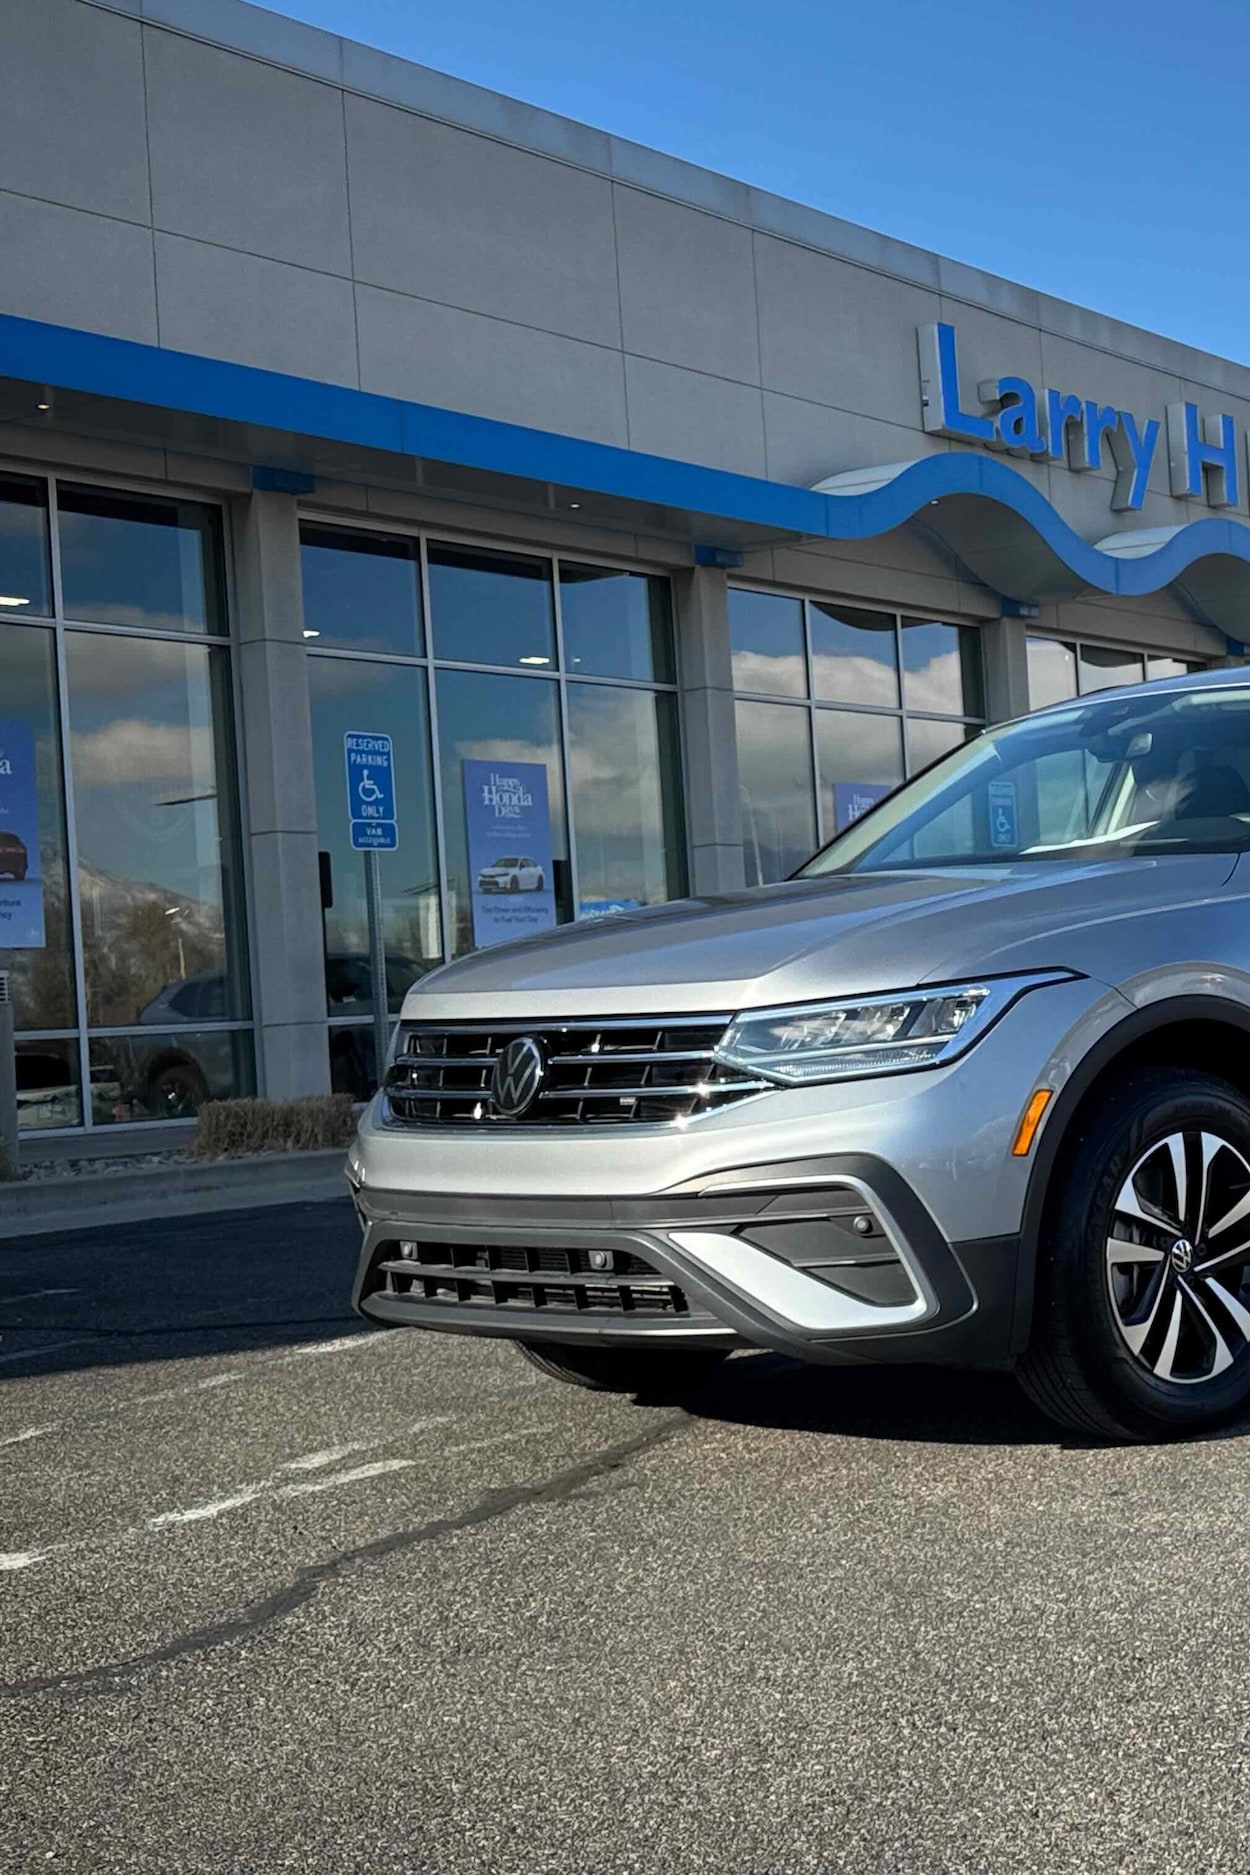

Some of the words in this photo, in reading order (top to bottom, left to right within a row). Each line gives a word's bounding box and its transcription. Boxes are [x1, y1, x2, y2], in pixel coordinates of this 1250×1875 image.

[925, 321, 1160, 512] Larry
[1174, 402, 1238, 507] H
[347, 737, 390, 753] RESERVED
[350, 753, 389, 768] PARKING
[481, 785, 533, 807] Honda
[361, 804, 385, 818] ONLY
[365, 826, 383, 837] VAN
